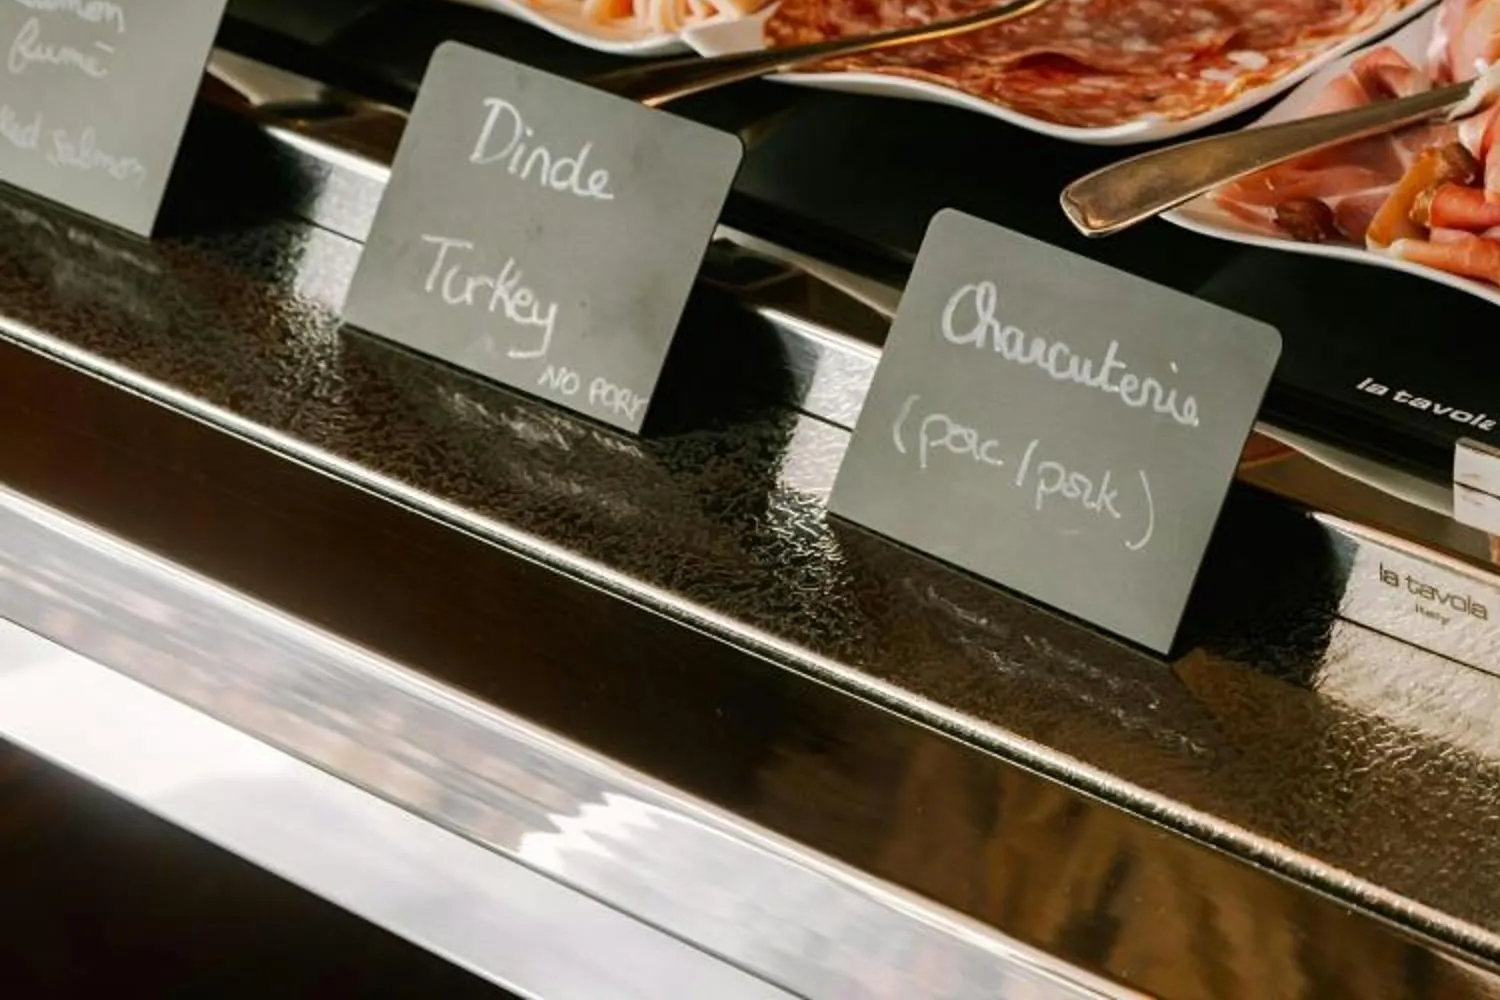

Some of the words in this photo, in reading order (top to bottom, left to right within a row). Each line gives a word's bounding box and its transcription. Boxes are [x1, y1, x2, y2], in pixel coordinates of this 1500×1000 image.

[469, 96, 614, 200] Dinde
[421, 234, 559, 359] Turkey
[537, 365, 579, 395] NO
[589, 377, 649, 421] PORK
[942, 281, 1199, 427] Charcuterie
[1356, 377, 1390, 397] la
[1379, 562, 1399, 587] la
[1404, 575, 1489, 621] tavola
